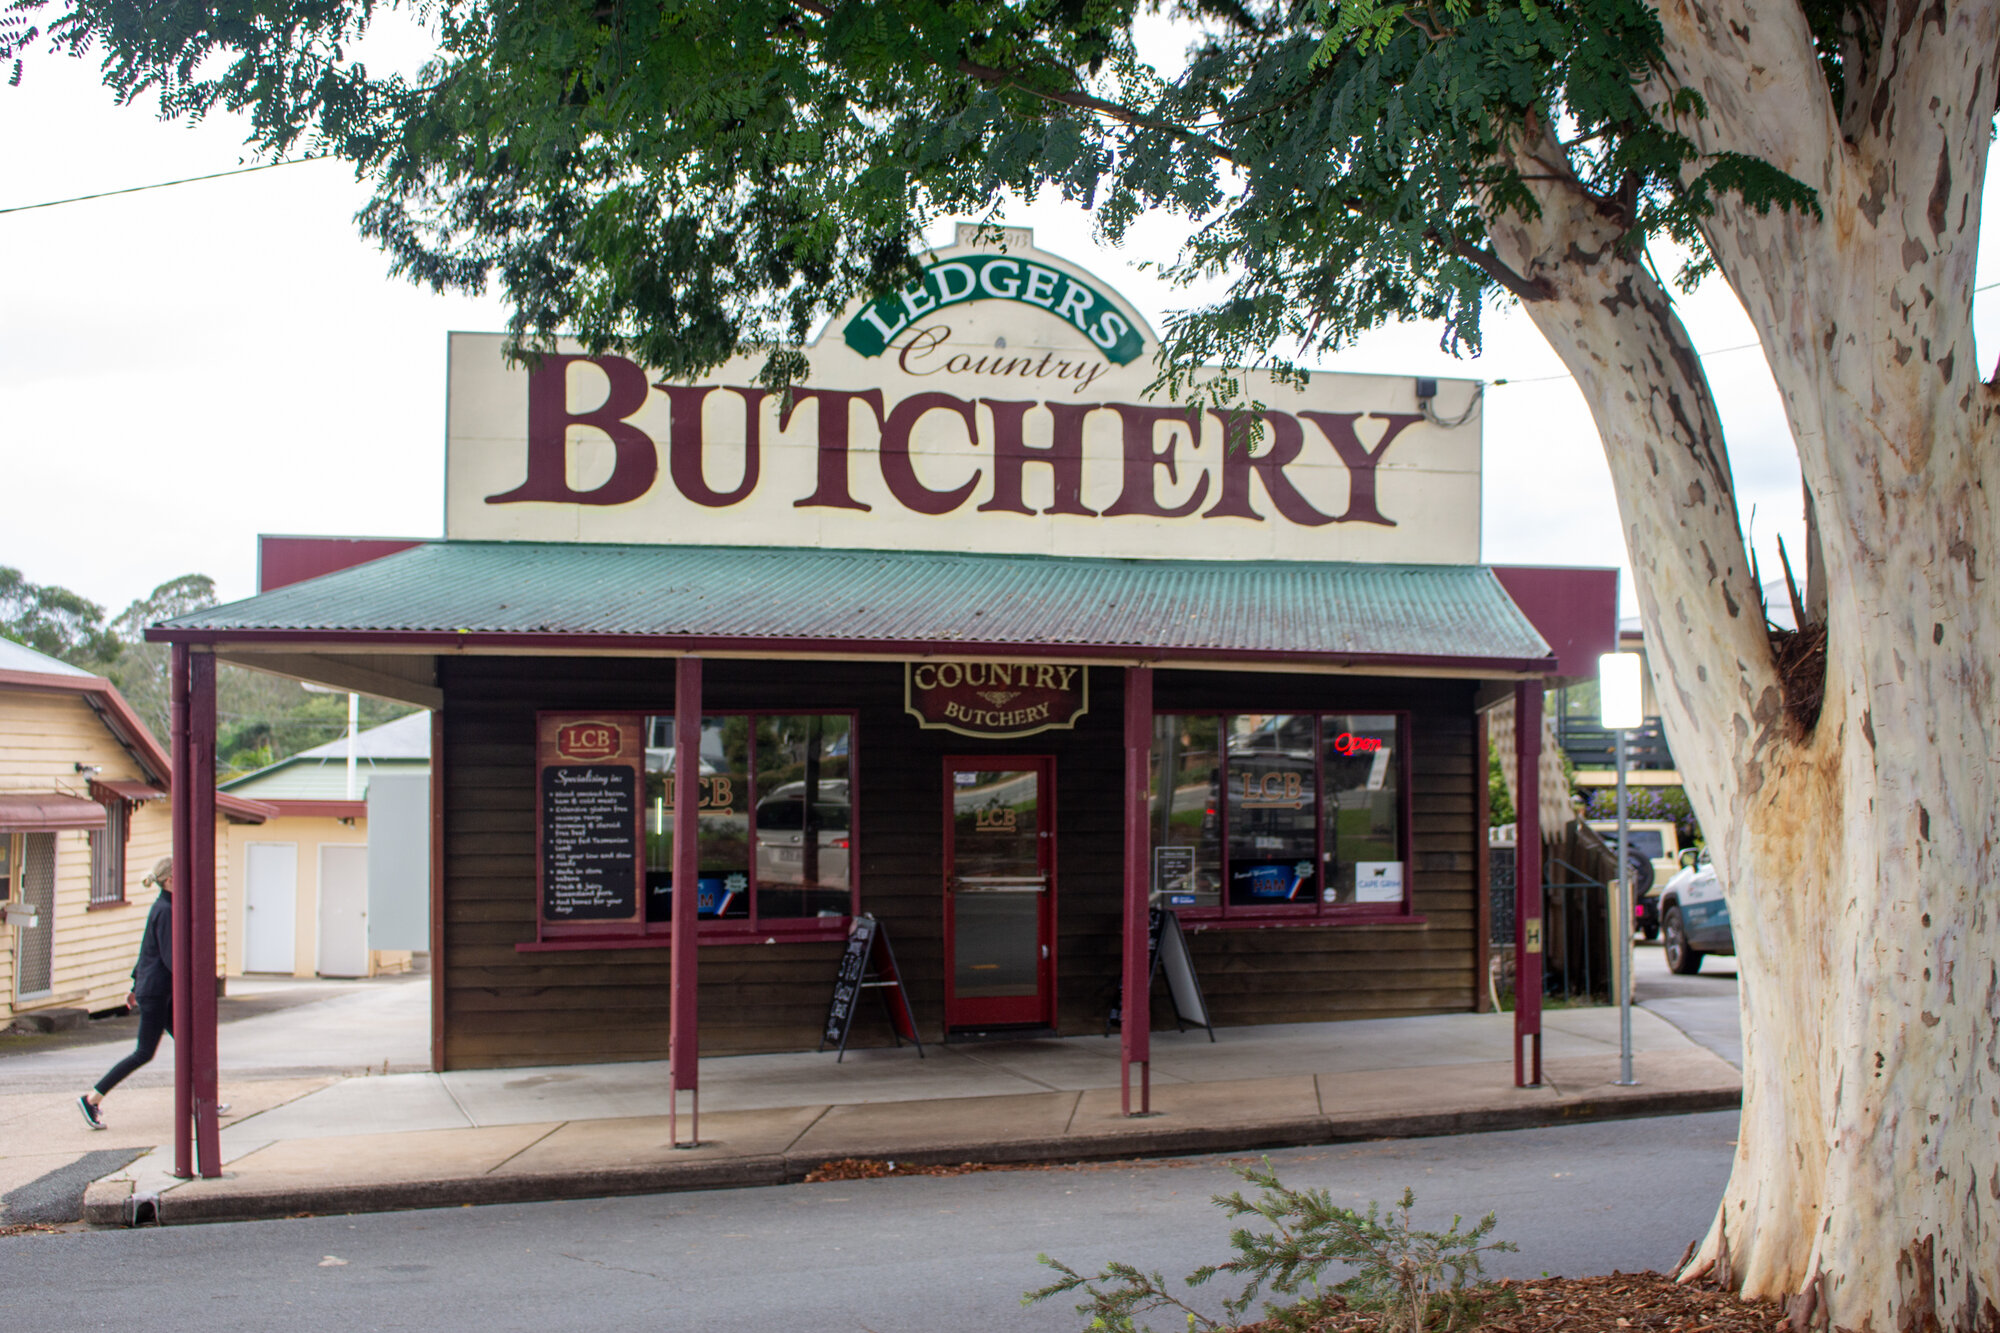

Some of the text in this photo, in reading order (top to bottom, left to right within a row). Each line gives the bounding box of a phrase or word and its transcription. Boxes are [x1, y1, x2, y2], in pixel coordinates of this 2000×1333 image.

[861, 259, 1129, 349] LEDGERS
[888, 325, 1109, 393] Country
[484, 353, 1428, 527] BUTCHERY
[914, 663, 1078, 691] COUNTRY
[944, 702, 1051, 726] BUTCHERY
[568, 730, 610, 748] LCB
[1334, 732, 1382, 756] Open
[1241, 772, 1303, 800] LCB
[976, 808, 1017, 826] LCB
[1253, 878, 1286, 893] HAM
[1528, 927, 1539, 944] H
